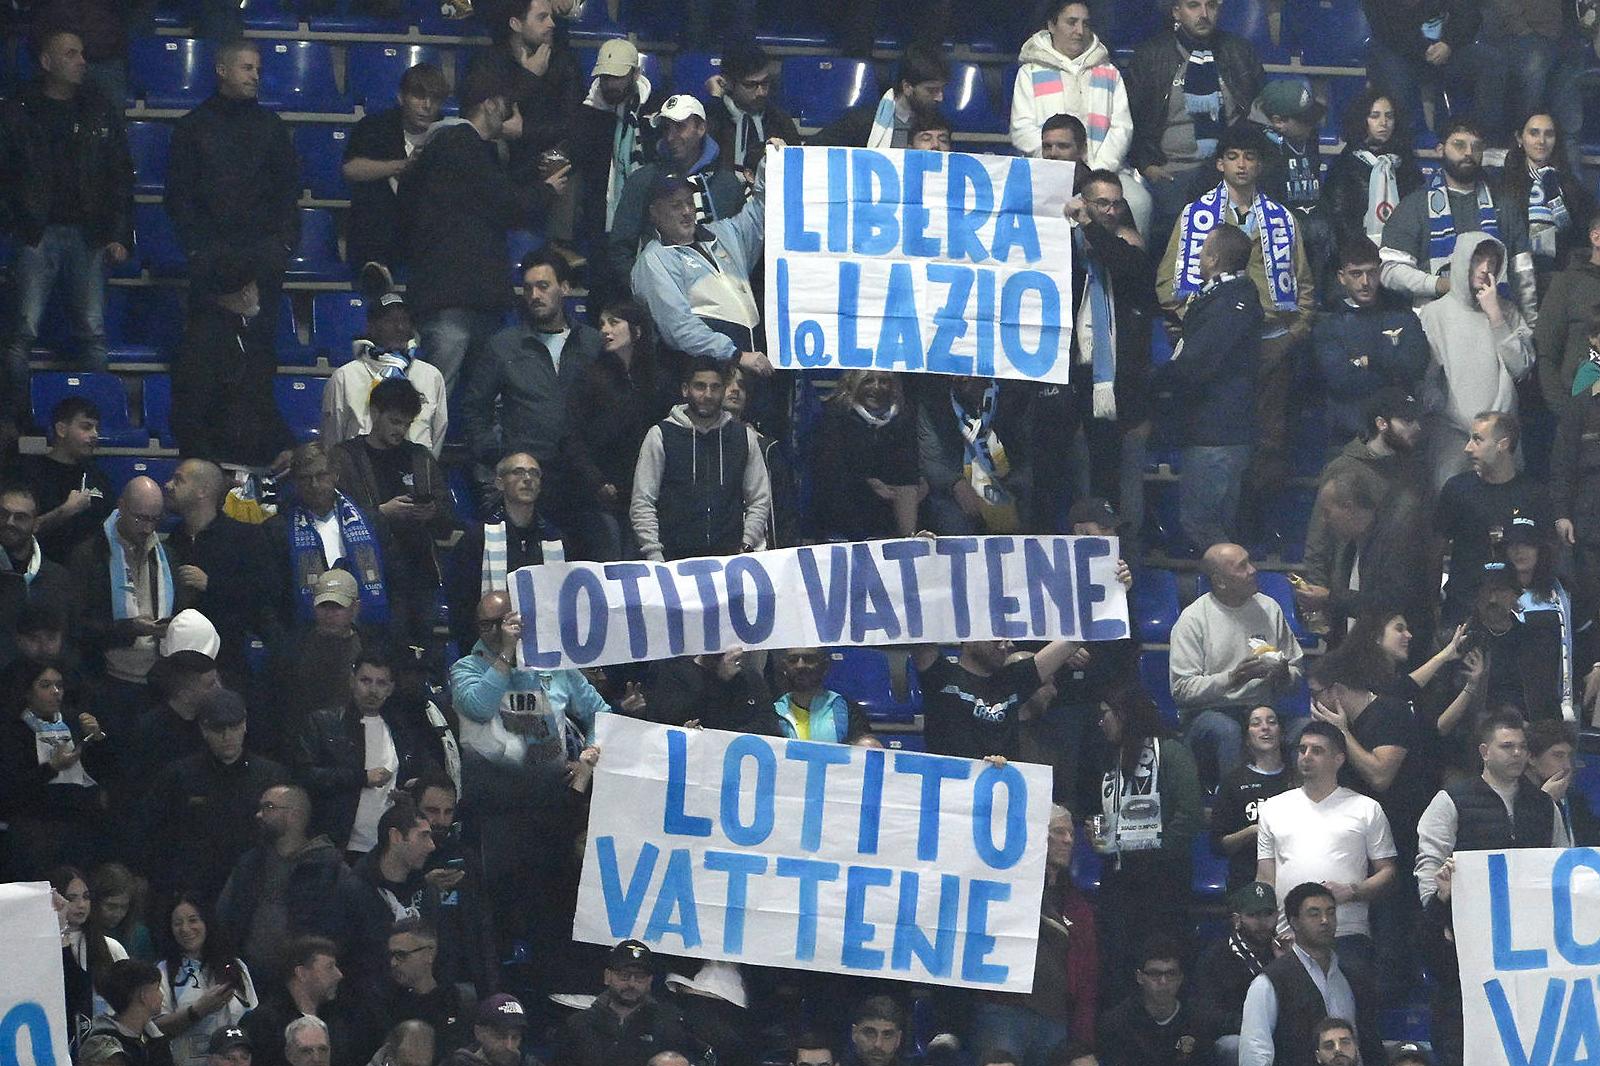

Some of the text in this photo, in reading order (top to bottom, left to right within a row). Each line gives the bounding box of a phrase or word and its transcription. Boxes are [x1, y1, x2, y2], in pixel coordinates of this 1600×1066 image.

[784, 147, 1041, 263] LIBERA
[777, 258, 1061, 377] la LAZIO
[517, 538, 1125, 666] LOTITO VATTENE
[664, 729, 1027, 869] LOTITO
[596, 836, 1011, 983] VATTENE
